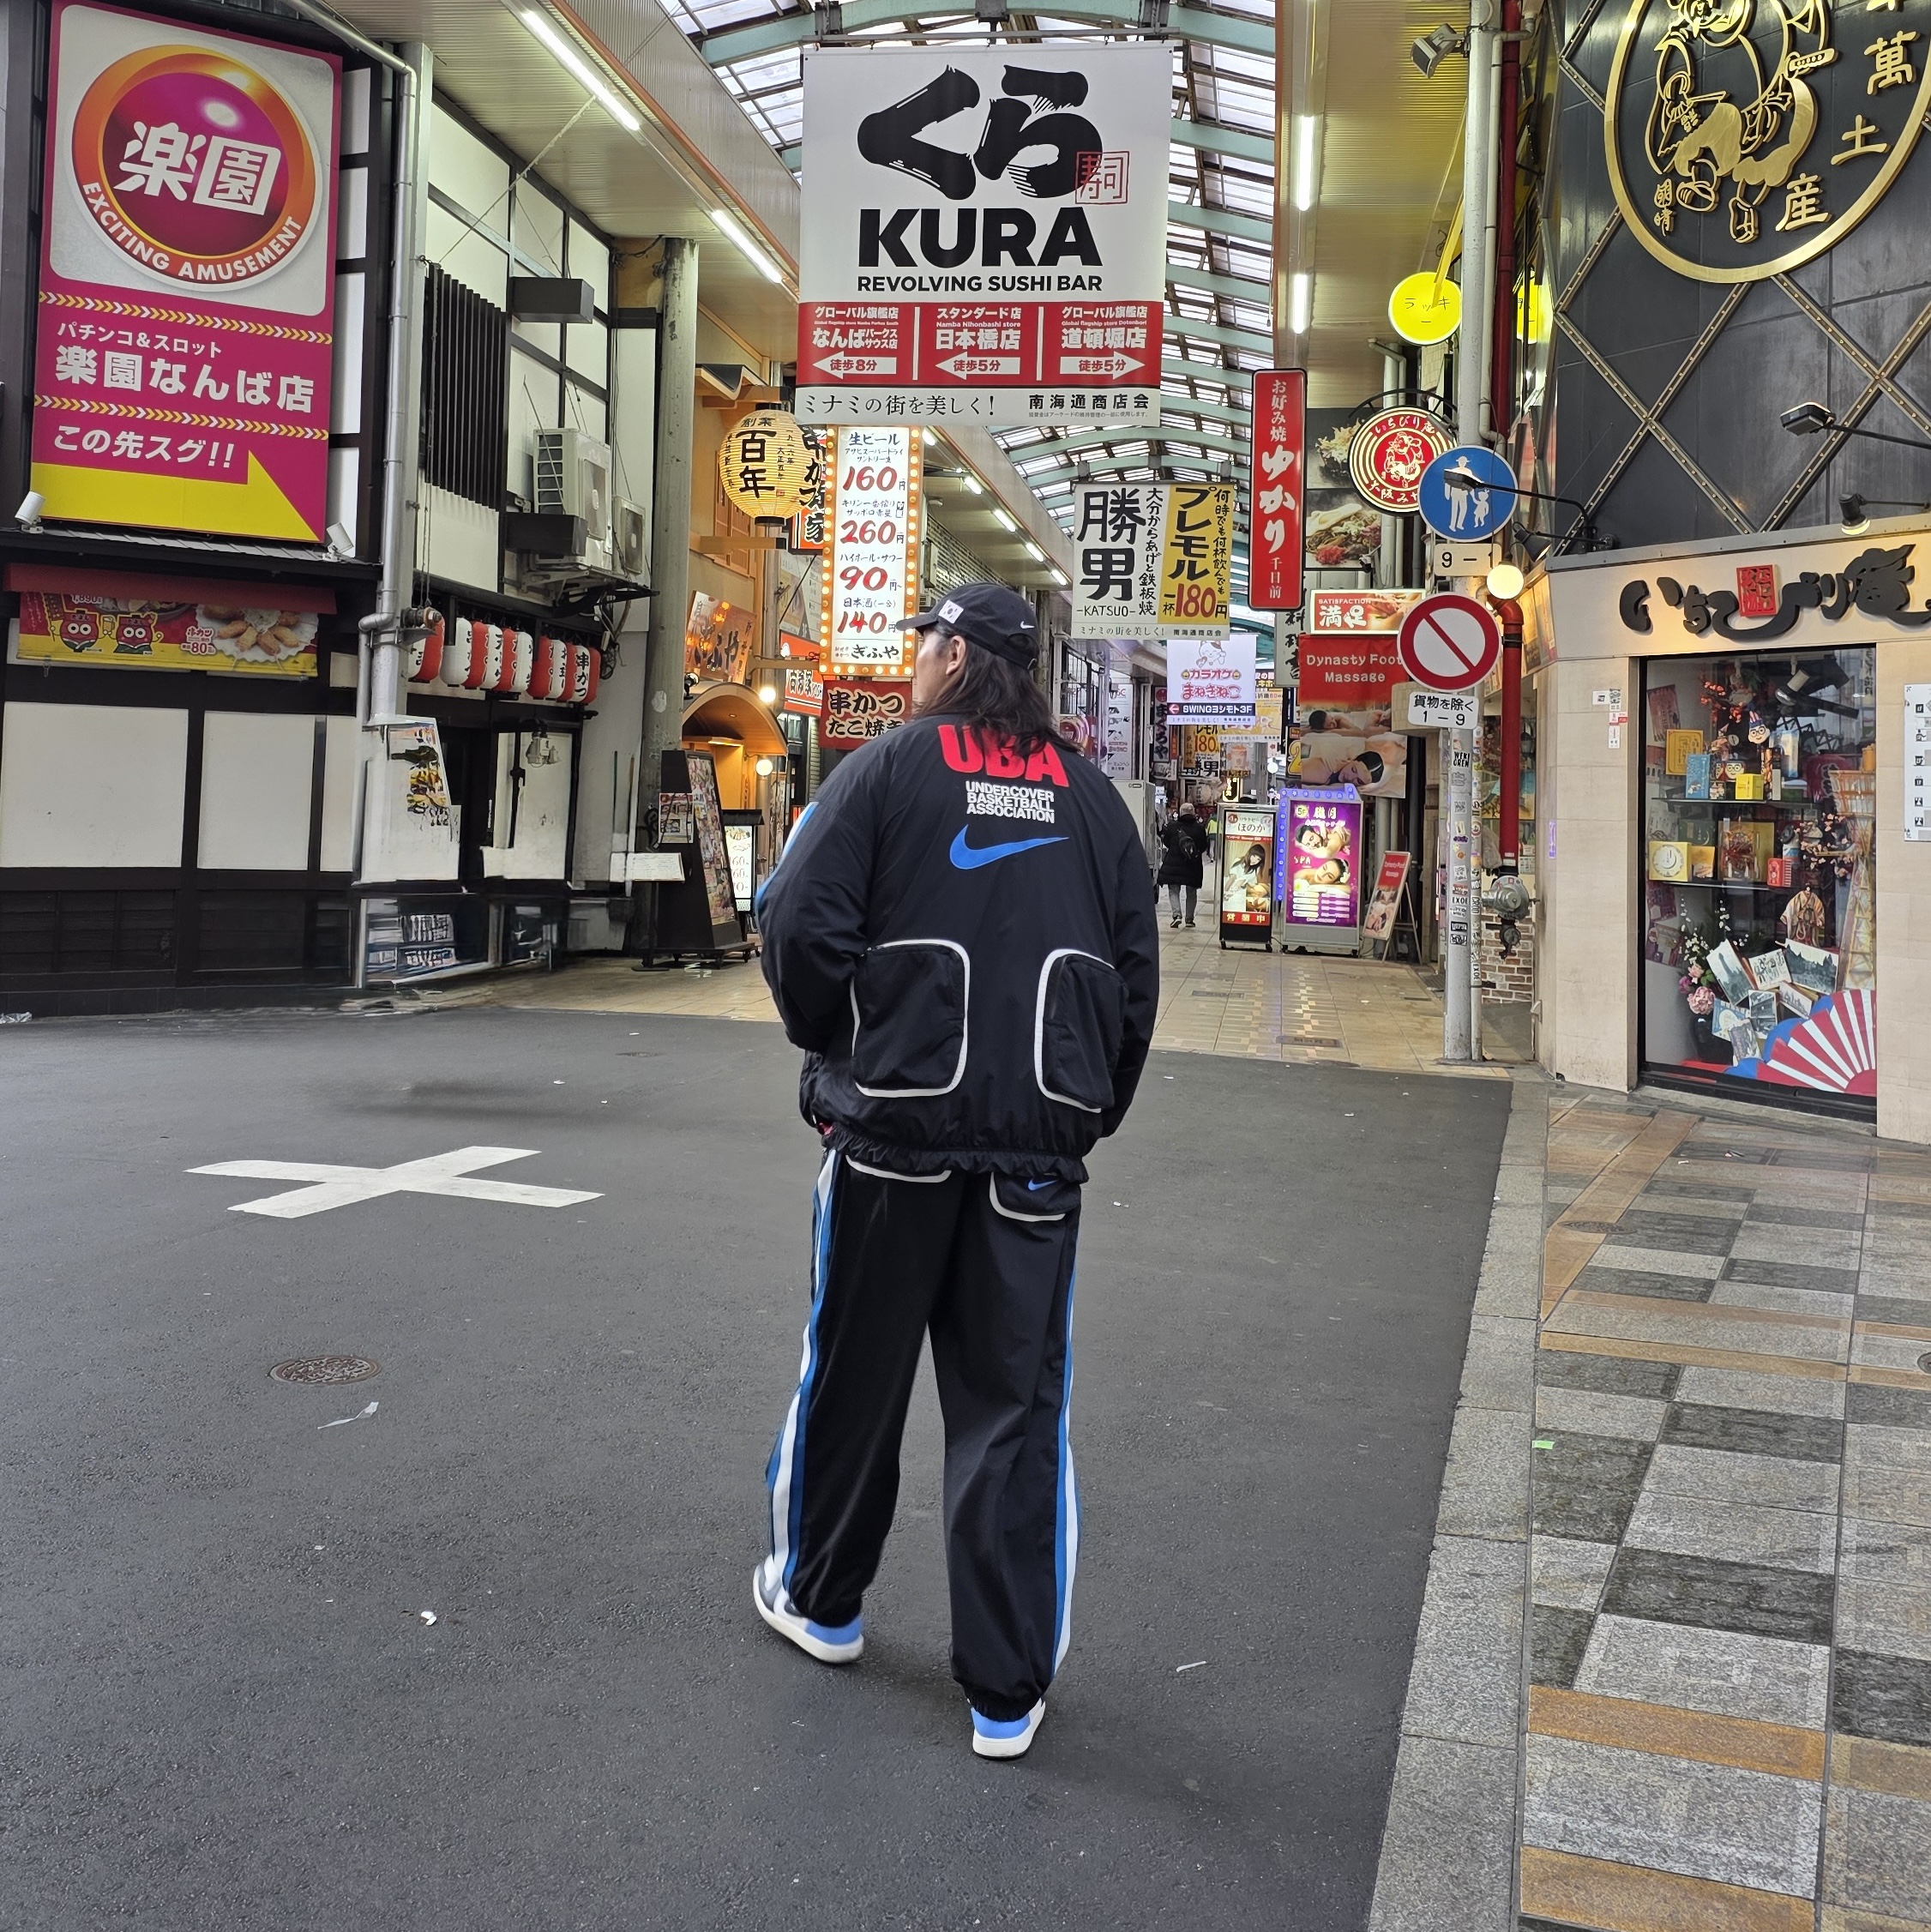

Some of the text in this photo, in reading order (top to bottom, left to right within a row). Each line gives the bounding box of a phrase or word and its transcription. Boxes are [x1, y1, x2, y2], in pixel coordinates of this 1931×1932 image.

[857, 63, 1103, 201] くら
[115, 122, 281, 216] 楽園
[1077, 153, 1128, 202] 寿司
[82, 182, 302, 281] EXCITING AMUSEMENT
[859, 207, 1103, 268] KURA
[857, 275, 1103, 292] REVOLVING SUSHI BAR
[815, 306, 899, 319] グローバル旗艦店
[1062, 306, 1148, 319] グローバル旗艦店
[57, 321, 222, 358] パチンコ&スロット
[812, 328, 865, 348] なんば
[935, 328, 1021, 350] 日本橋店
[1061, 328, 1147, 349] 道頓堀店
[830, 358, 878, 371] 徒歩8分
[953, 359, 1002, 372] 徒歩5分
[1079, 359, 1127, 372] 徒歩5分
[55, 346, 314, 413] 楽園なんば店
[805, 394, 995, 416] ミナミの街を美しく!
[1029, 394, 1150, 410] 南海通商店会
[1270, 380, 1287, 443] お好み焼
[741, 417, 775, 427] 創業
[1375, 416, 1435, 434] いちびり庵
[849, 431, 901, 446] 生ビール
[735, 430, 778, 499] 百年
[1259, 444, 1296, 554] ゆかり
[1077, 488, 1146, 601] 勝男
[1167, 486, 1218, 581] プレモル
[1212, 489, 1231, 595] 何時でも何杯飲んでも
[1138, 487, 1164, 617] 大分からあげと鉄板焼
[1269, 557, 1283, 599] 千日前
[1619, 544, 1931, 641] いちびり庵
[1320, 605, 1367, 629] 満足
[851, 644, 899, 659] ぎふや
[1306, 653, 1403, 667] Dynasty Foot
[575, 652, 590, 697] 串かつ
[1188, 669, 1233, 681] カラオケ
[1325, 671, 1386, 683] Massage
[828, 687, 903, 716] 串かつ
[1181, 682, 1242, 701] まねきねこ
[1414, 694, 1475, 713] 貨物を除く
[937, 724, 1070, 788] UBA
[966, 780, 1055, 803] UNDERCOVER
[967, 791, 1055, 813] BASKETBALL
[966, 803, 1055, 824] ASSOCIATION
[1297, 807, 1306, 816] 5F
[1237, 822, 1266, 833] ほのか
[1294, 855, 1311, 865] SPA
